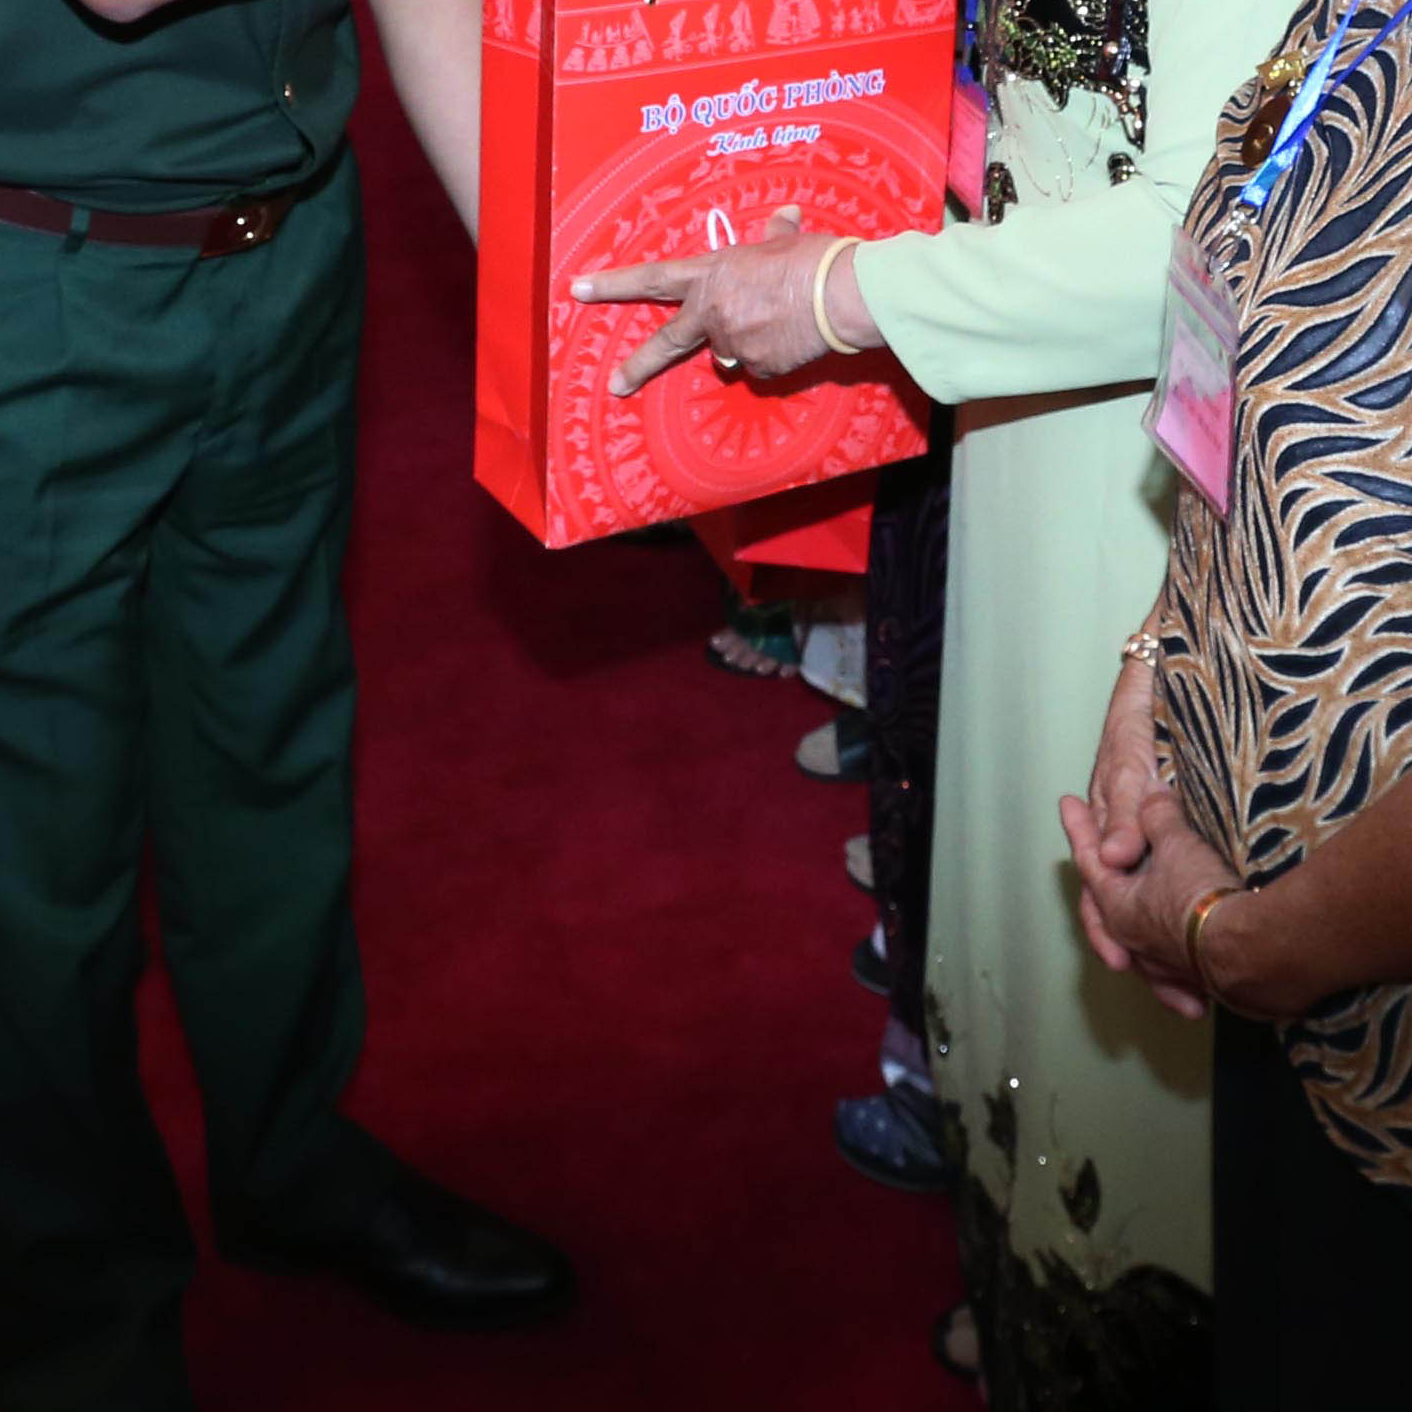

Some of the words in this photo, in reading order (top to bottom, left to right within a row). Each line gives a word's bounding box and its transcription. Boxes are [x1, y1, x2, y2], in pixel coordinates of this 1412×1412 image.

[641, 94, 686, 134] BỘ
[692, 79, 778, 127] QUỐC
[782, 68, 886, 109] PHÒNG
